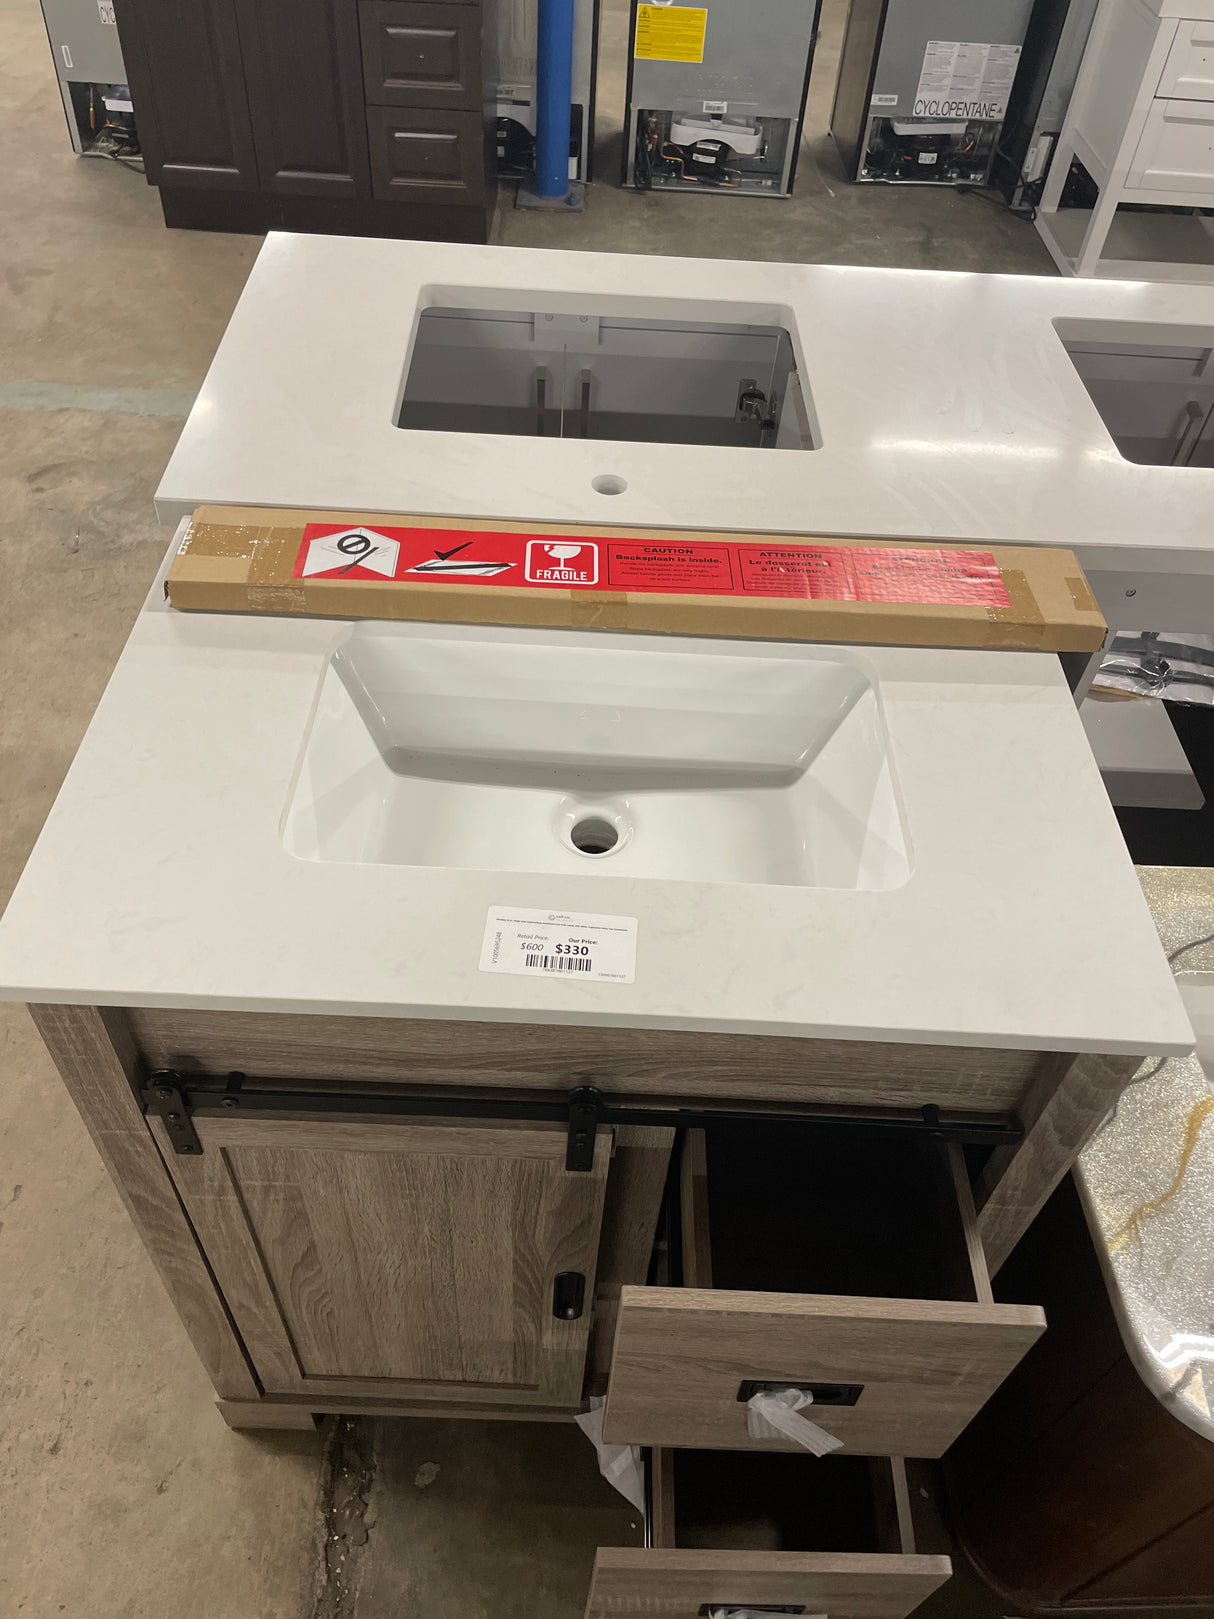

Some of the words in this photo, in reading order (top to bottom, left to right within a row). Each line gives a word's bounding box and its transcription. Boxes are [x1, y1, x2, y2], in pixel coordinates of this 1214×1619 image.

[914, 99, 998, 118] CYCLOPENTANE
[616, 554, 675, 562] Backsplash
[759, 551, 822, 559] ATTENTION
[536, 569, 588, 581] FRAGILE
[520, 942, 544, 952] $600
[555, 943, 589, 956] $330
